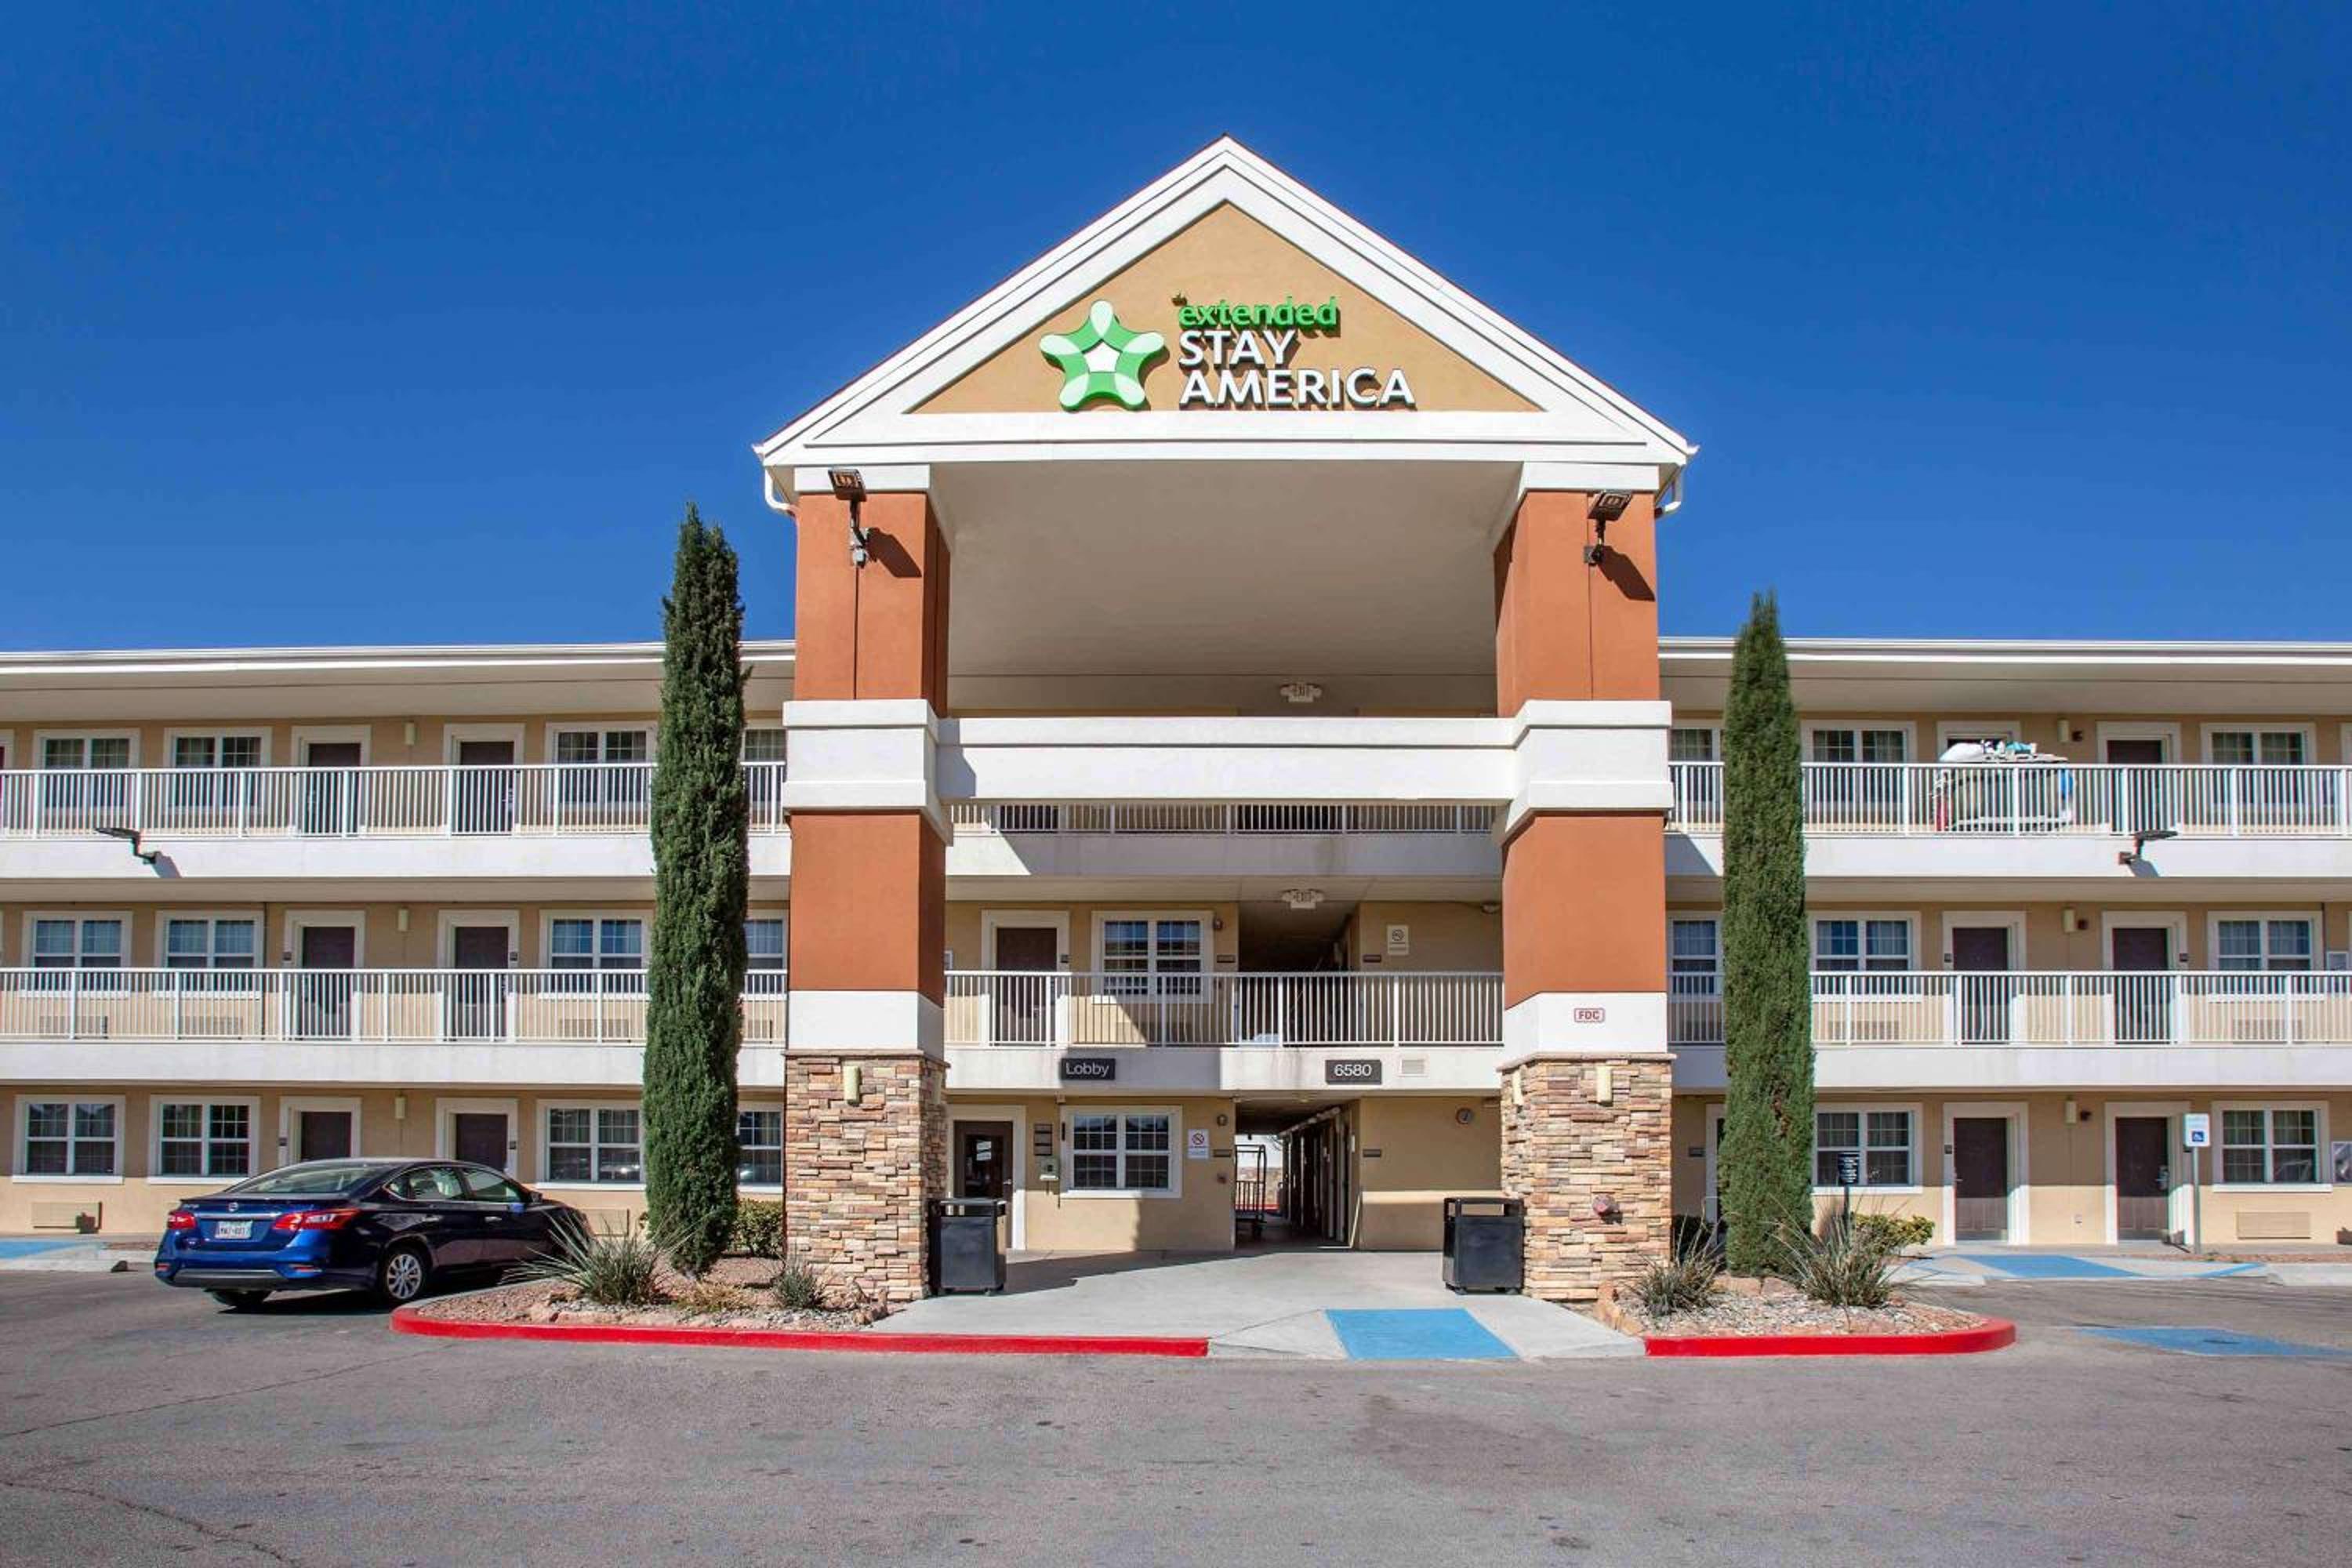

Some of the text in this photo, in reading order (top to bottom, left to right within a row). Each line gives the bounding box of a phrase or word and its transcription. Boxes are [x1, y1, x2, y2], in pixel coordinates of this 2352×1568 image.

[1178, 296, 1338, 328] extended
[1178, 329, 1297, 367] STAY
[1178, 368, 1416, 405] AMERICA
[1578, 1011, 1600, 1020] FDC
[1065, 1062, 1109, 1077] Lobby
[1334, 1064, 1373, 1076] 6580
